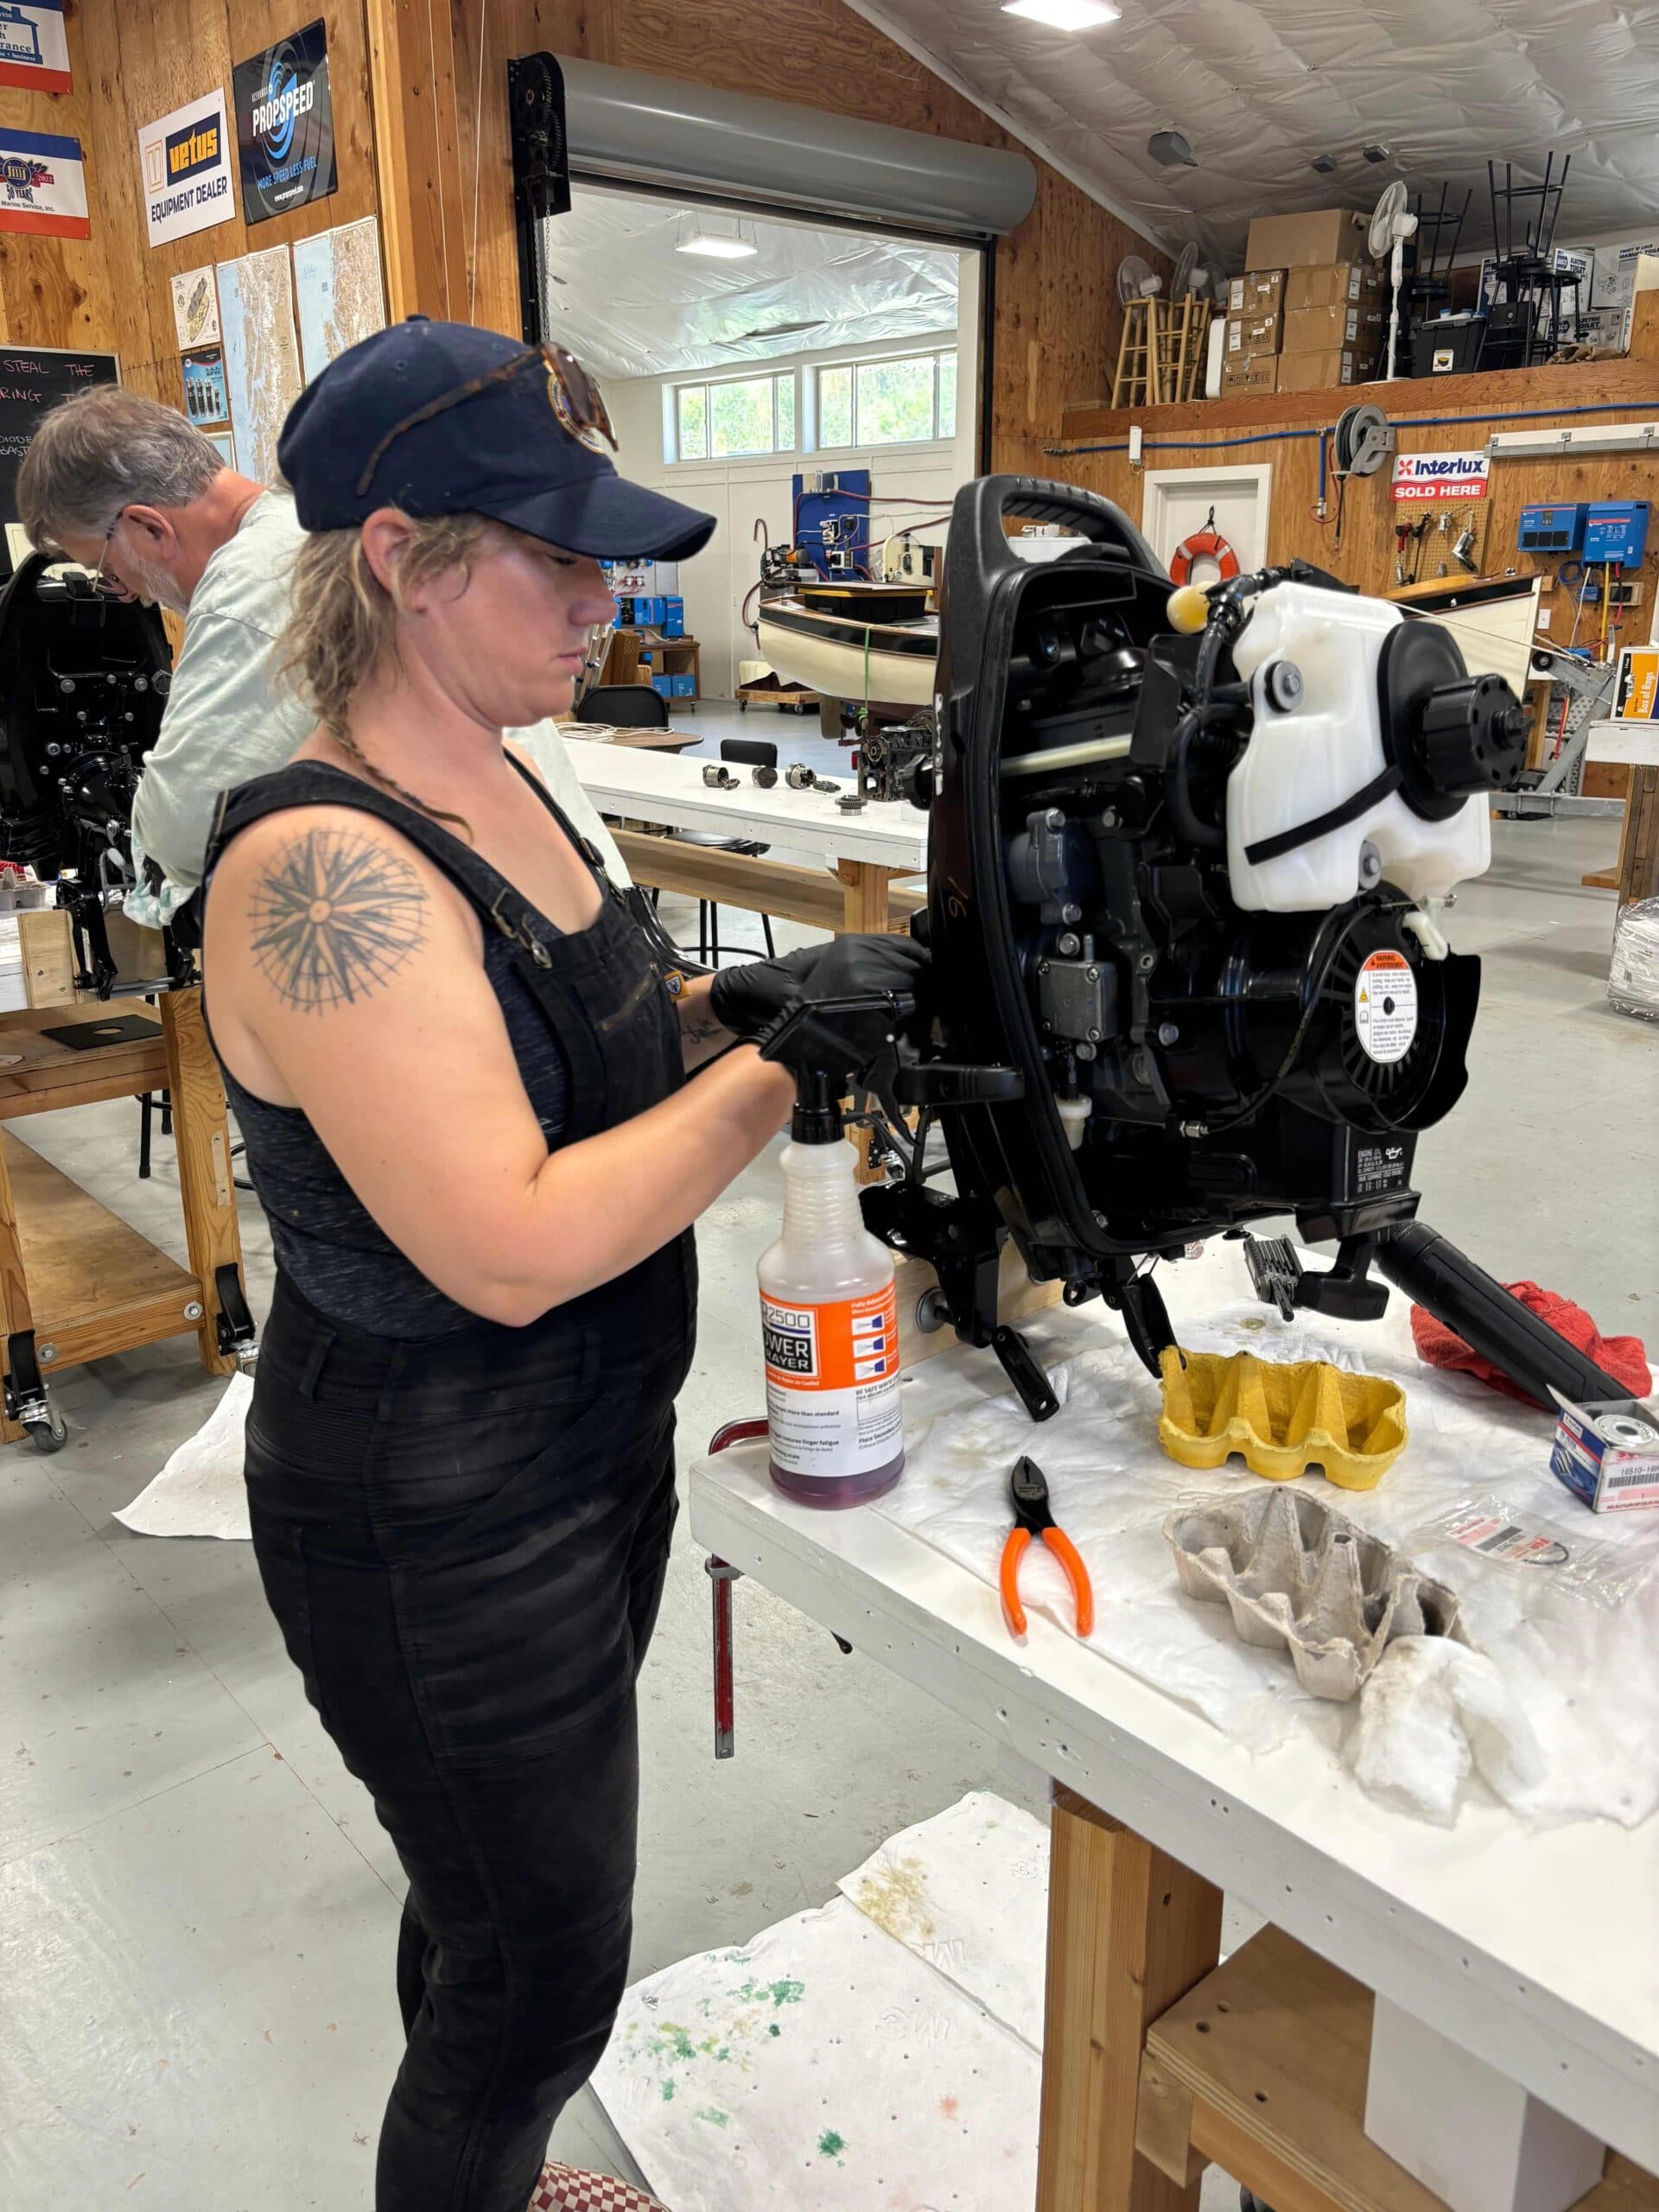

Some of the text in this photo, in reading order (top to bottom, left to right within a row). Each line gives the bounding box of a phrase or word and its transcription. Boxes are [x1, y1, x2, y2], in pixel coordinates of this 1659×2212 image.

[252, 80, 314, 137] PROPSPEED
[169, 128, 218, 174] vetus
[257, 156, 317, 190] MORE SPEED LESS FUEL
[16, 187, 34, 204] YEARS
[151, 175, 228, 224] EQUIPMENT DEALER
[3, 359, 95, 378] STEAL THE
[1415, 458, 1484, 475] Interlux
[1395, 484, 1482, 499] SOLD HERE
[1637, 671, 1656, 713] Box of Rags
